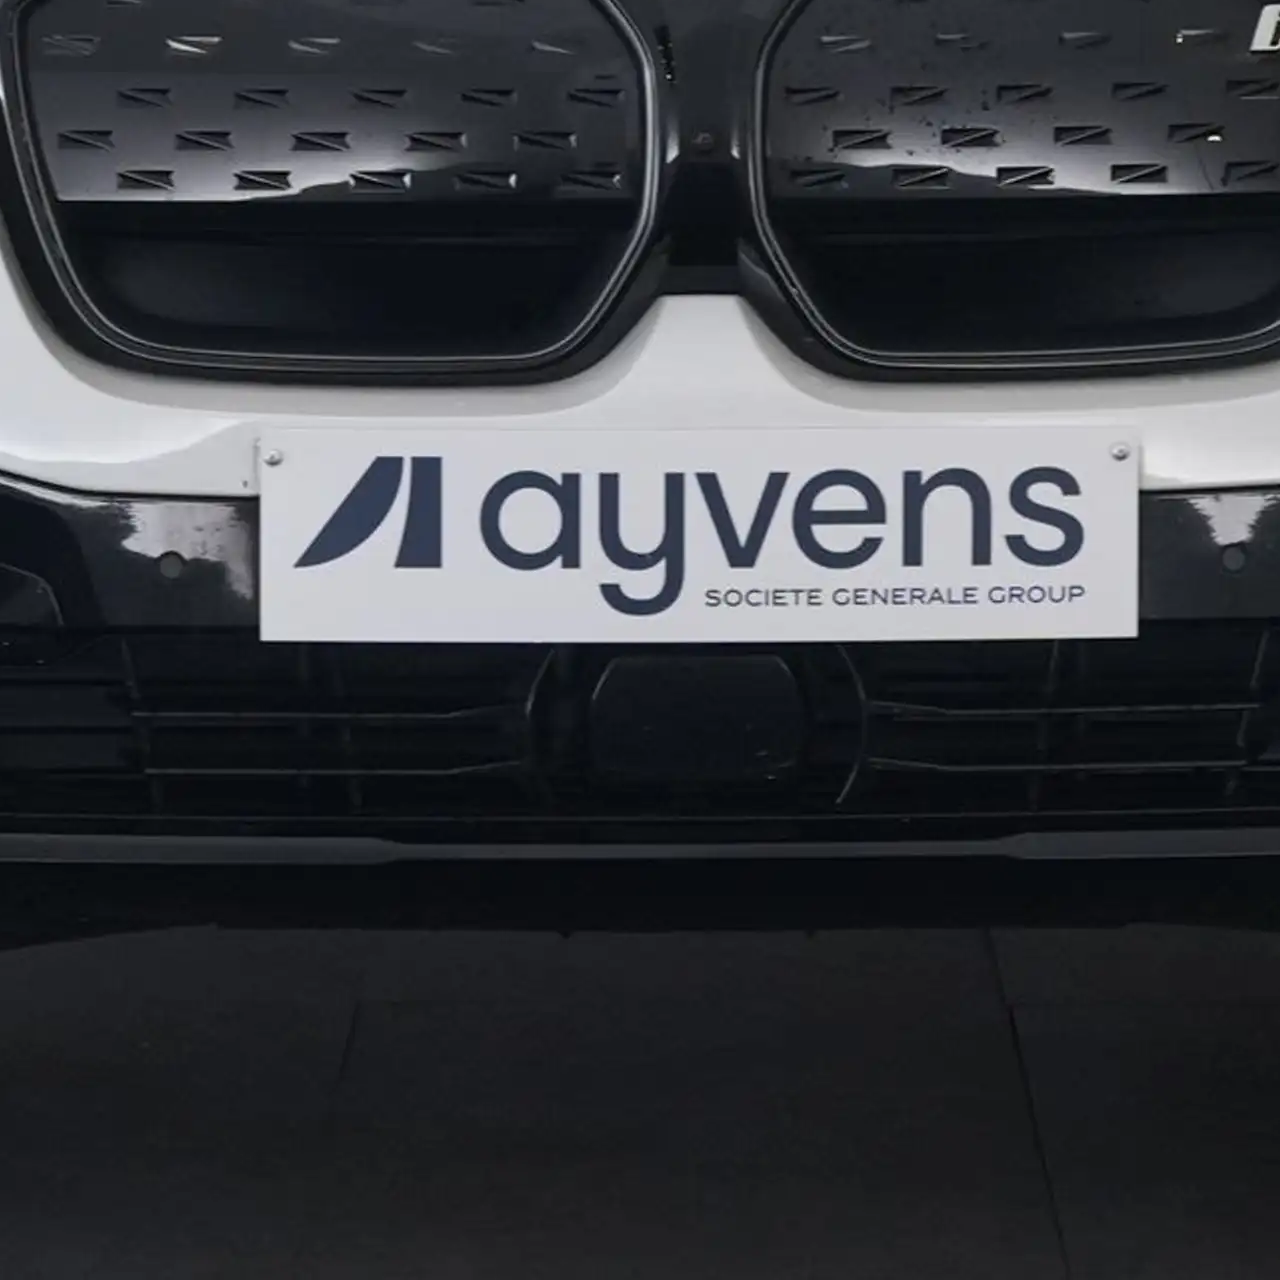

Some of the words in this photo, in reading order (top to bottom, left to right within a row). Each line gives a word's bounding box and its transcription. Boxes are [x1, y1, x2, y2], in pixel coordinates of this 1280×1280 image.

[479, 465, 1086, 618] ayvens
[704, 587, 824, 608] SOCIETE
[831, 586, 980, 607] GENERALE
[987, 584, 1087, 605] GROUP
